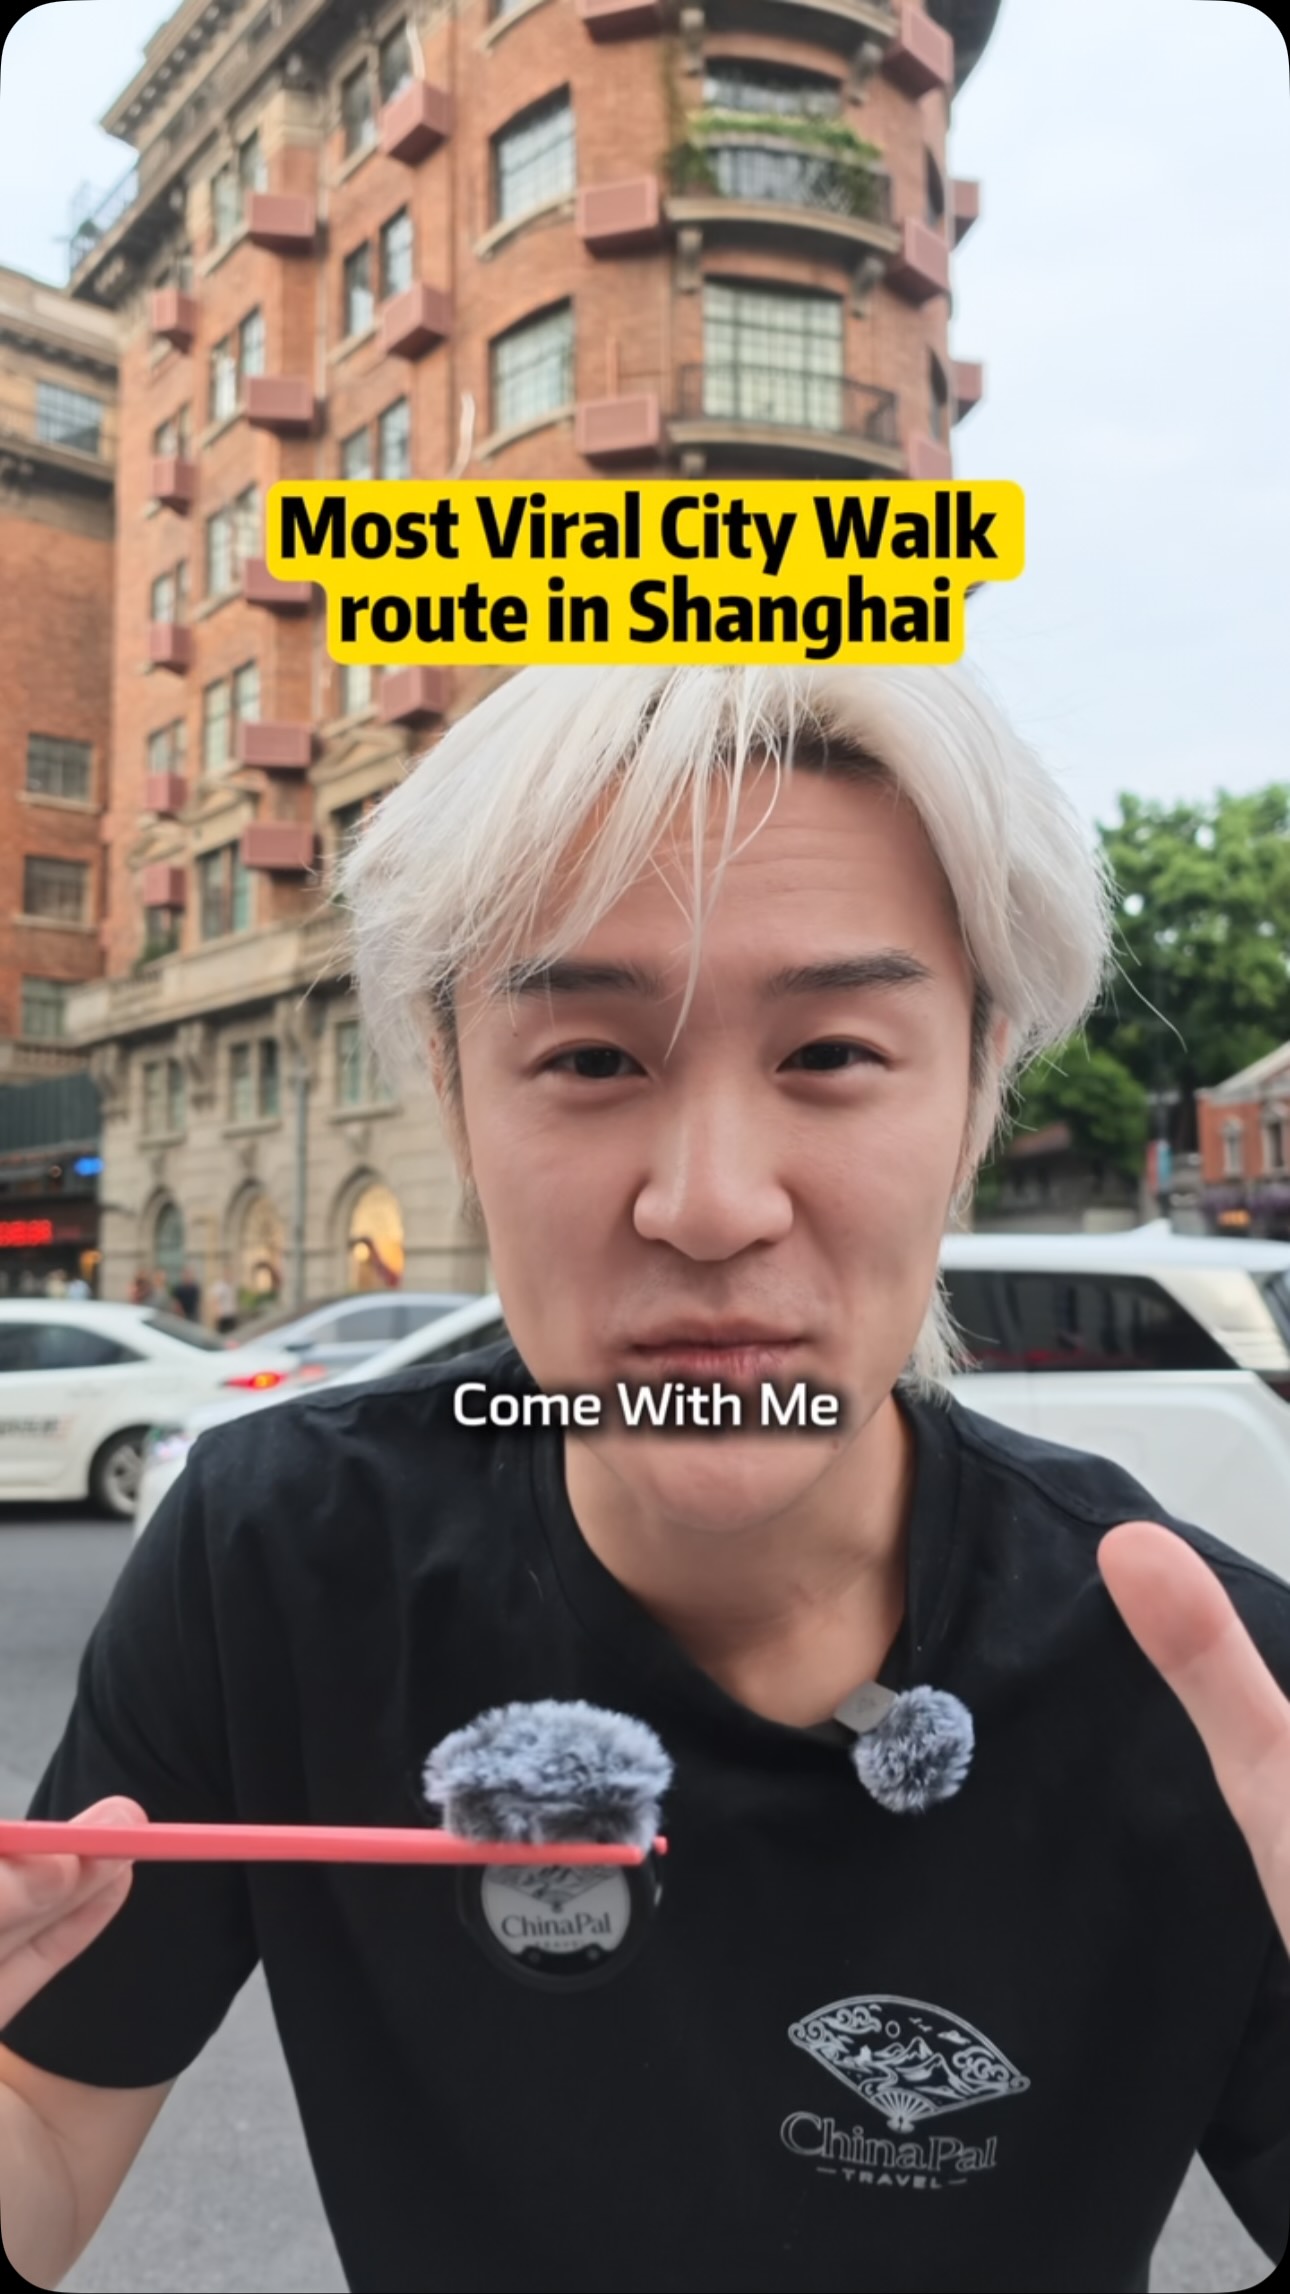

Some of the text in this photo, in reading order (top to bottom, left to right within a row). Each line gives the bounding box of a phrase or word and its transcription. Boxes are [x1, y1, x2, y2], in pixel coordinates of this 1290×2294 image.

[501, 1912, 612, 1938] ChinaPal
[780, 2111, 998, 2172] ChinaPal
[842, 2167, 943, 2190] TRAVEL
